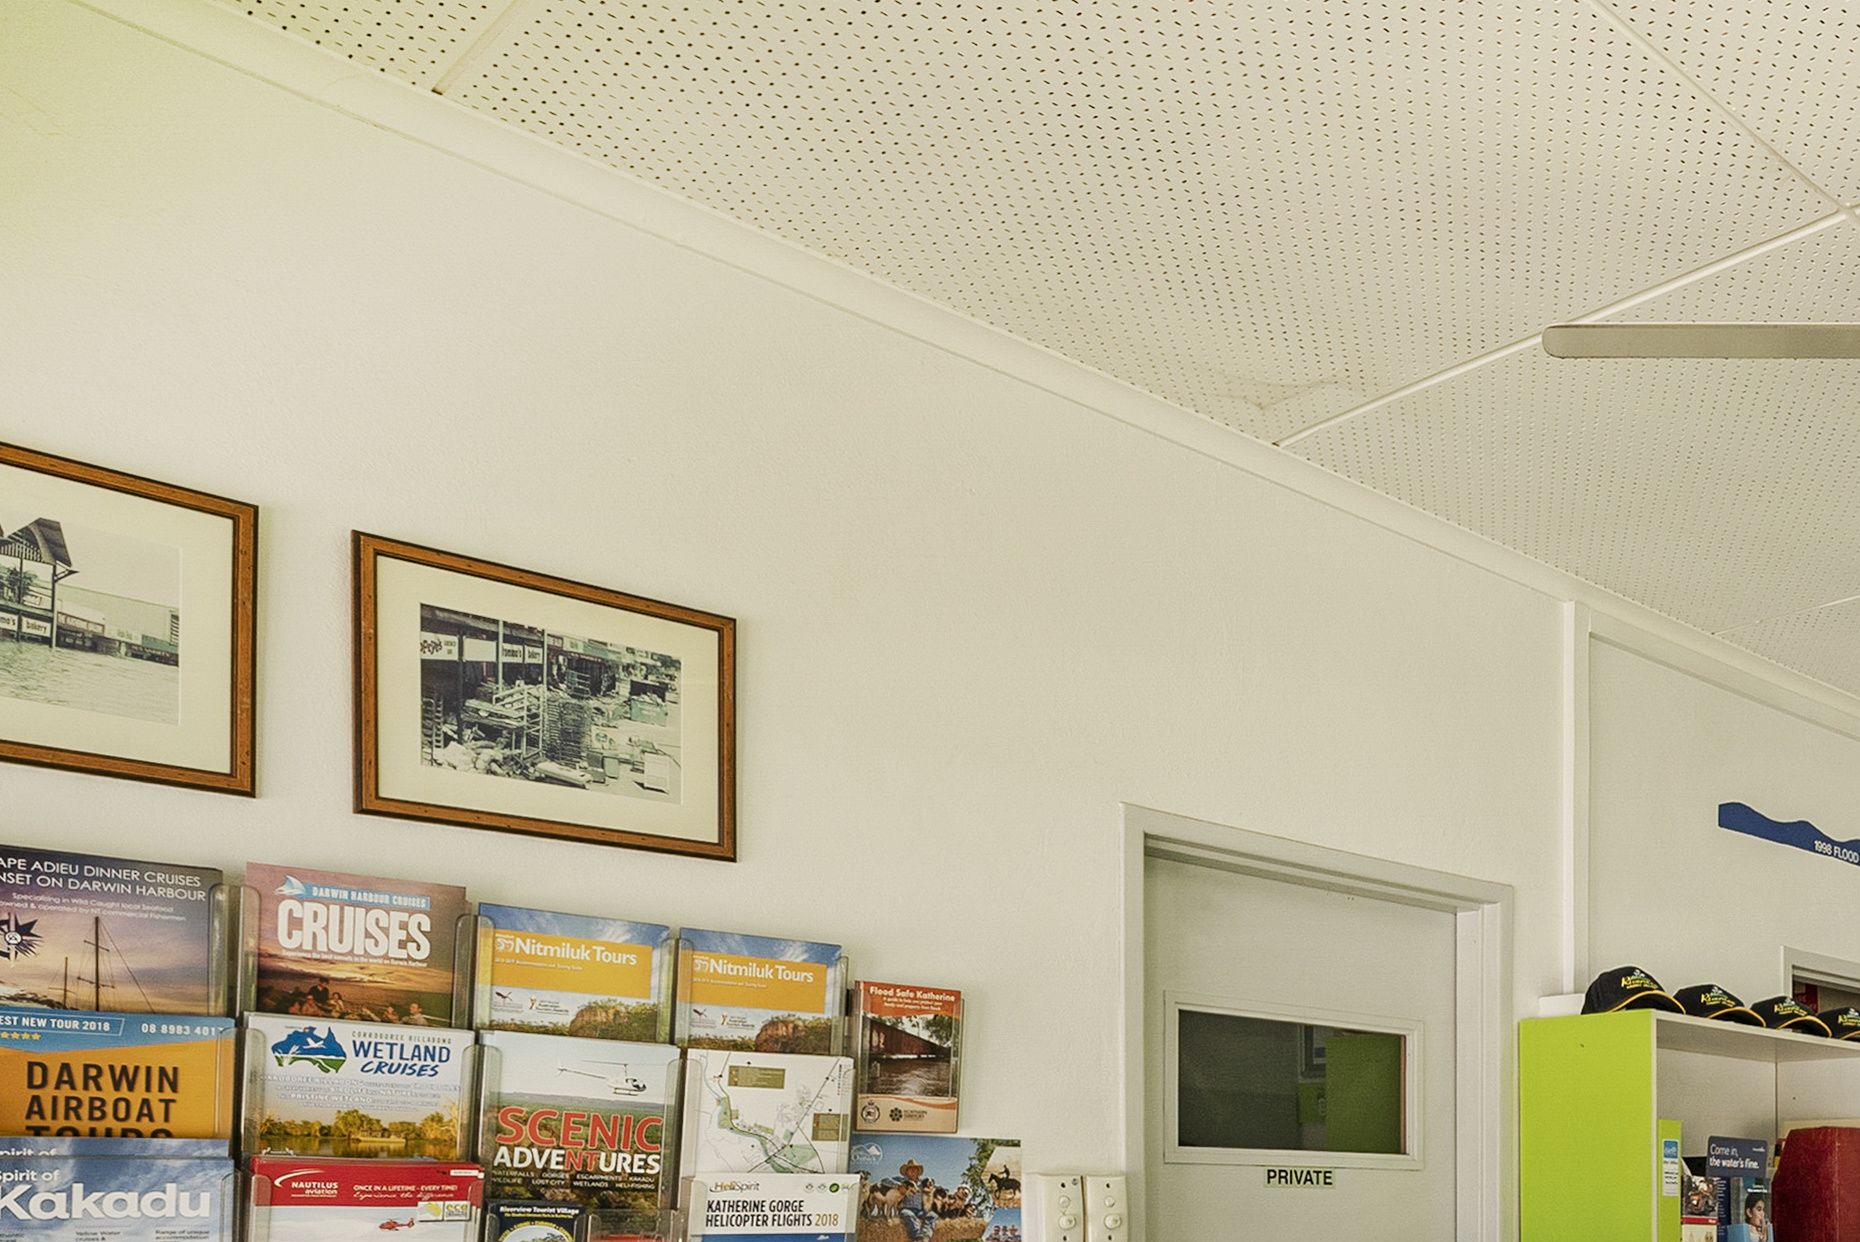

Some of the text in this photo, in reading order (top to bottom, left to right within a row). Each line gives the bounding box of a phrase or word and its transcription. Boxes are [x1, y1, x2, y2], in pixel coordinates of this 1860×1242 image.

[1814, 840, 1832, 856] 1998
[1833, 847, 1859, 863] FLOOD
[0, 858, 200, 886] APE ADIEU DINNER CRUISES
[0, 872, 206, 901] NSET ON DARWIN HARBOUR
[312, 887, 426, 908] DARWIN HARBOUR CRUISES
[278, 899, 431, 960] CRUISES
[515, 937, 590, 961] Nitmiluk
[593, 946, 637, 965] Tours
[710, 959, 814, 983] Nitmiluk Tours
[869, 986, 955, 1001] Flood Safe Katherine
[0, 1016, 110, 1031] EST NEW TOUR 2018
[352, 1040, 450, 1063] WETLAND
[27, 1061, 179, 1093] DARWIN
[361, 1061, 439, 1077] CRUISES
[25, 1095, 177, 1122] AIRBOAT
[496, 1106, 664, 1152] SCENIC
[494, 1146, 661, 1174] ADVENTURES
[1710, 1157, 1759, 1169] the water's fine.
[1267, 1169, 1333, 1185] PRIVATE
[0, 1183, 210, 1220] Kakadu
[707, 1200, 804, 1212] KATHERINE GORGE
[706, 1214, 839, 1227] HELICOPTER FLIGHTS 2018
